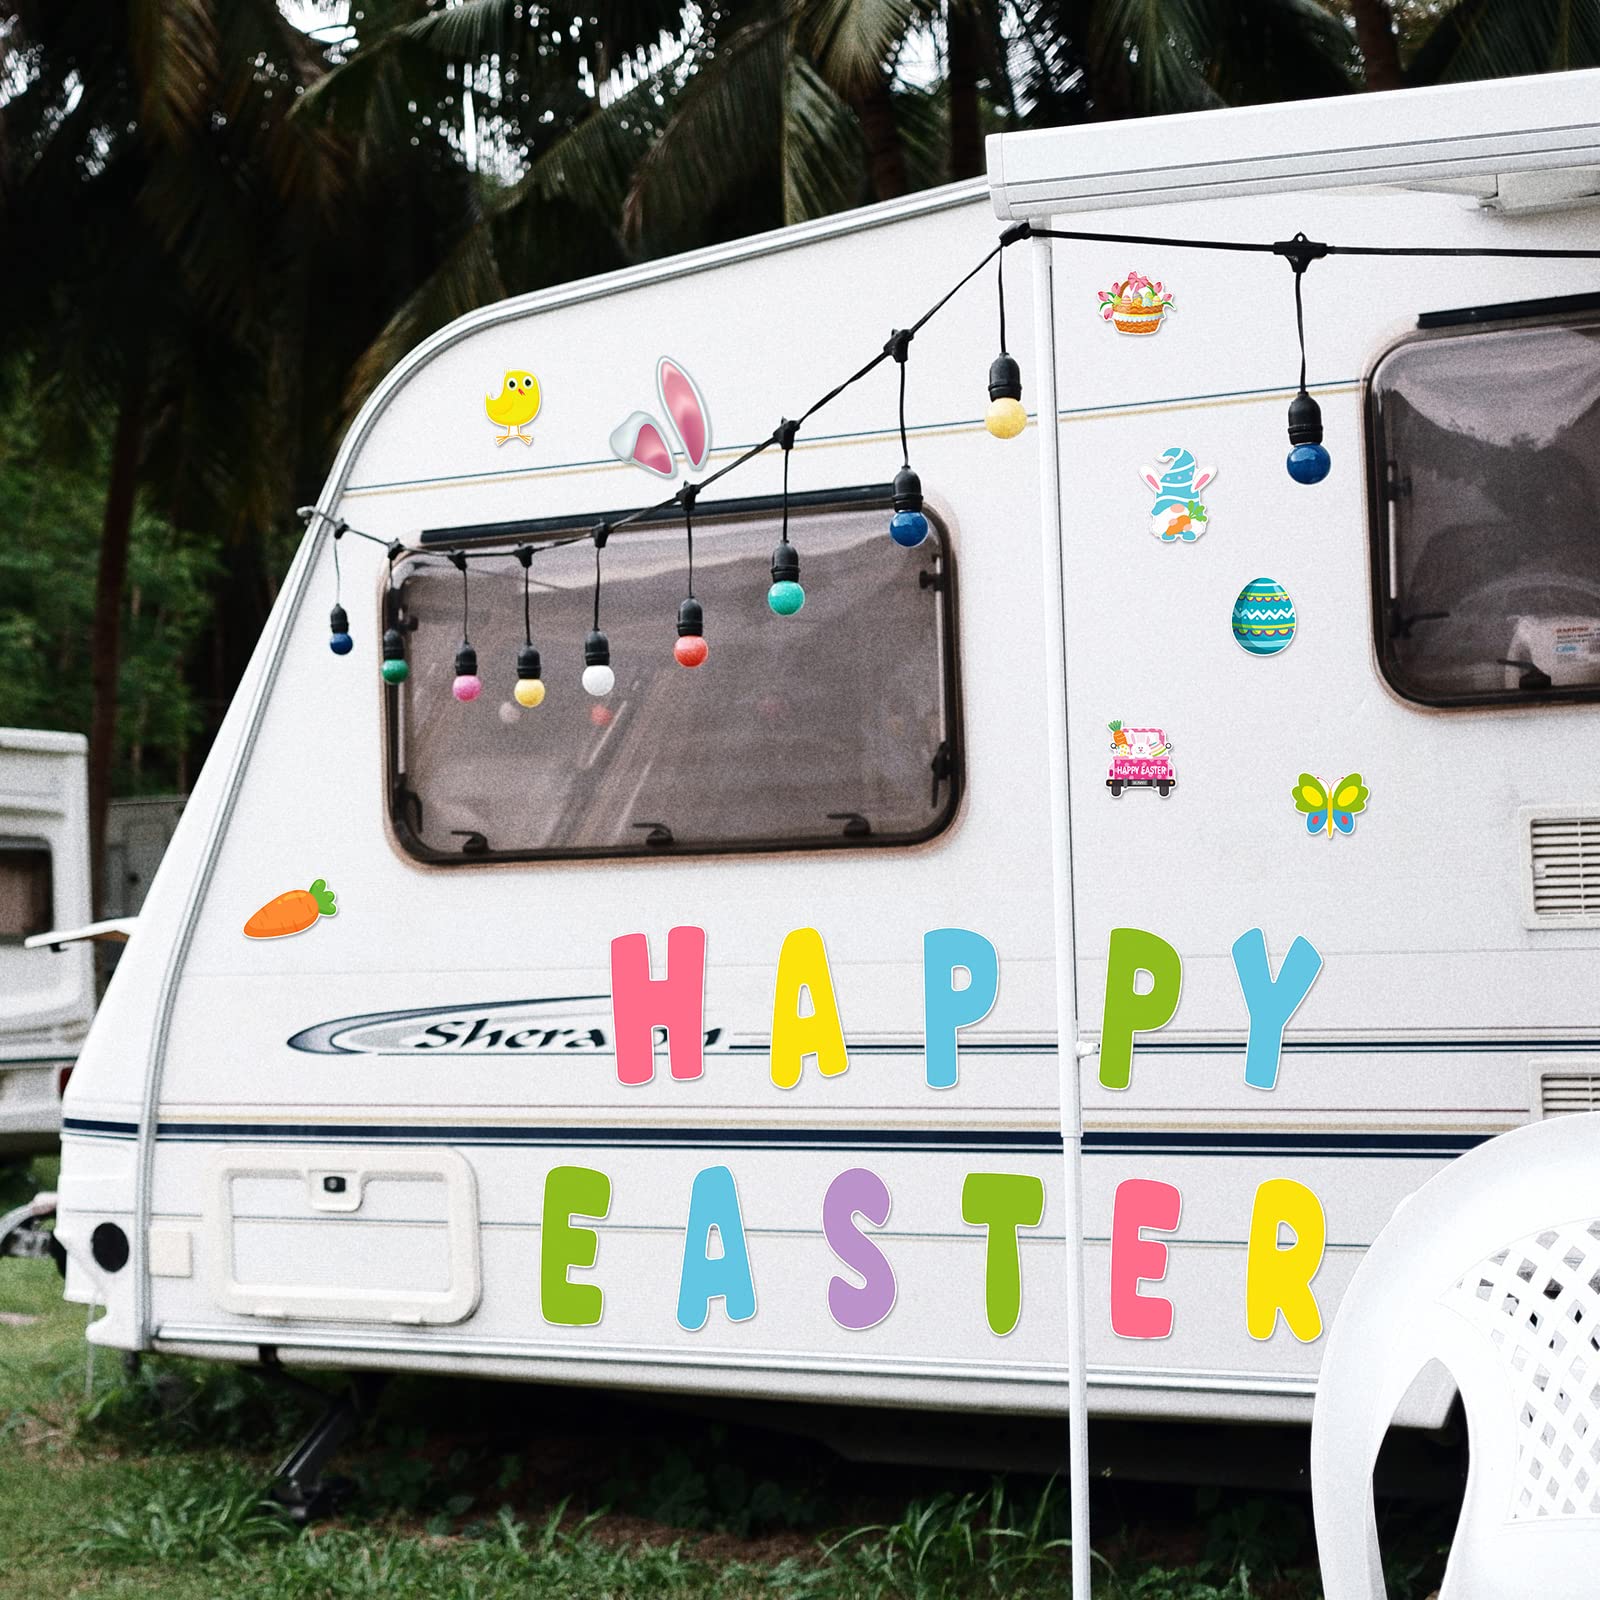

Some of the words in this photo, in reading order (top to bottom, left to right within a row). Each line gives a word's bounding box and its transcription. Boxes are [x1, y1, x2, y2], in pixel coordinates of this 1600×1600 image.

[1117, 766, 1139, 775] HAPPY
[1141, 766, 1167, 775] EASTER
[413, 1018, 722, 1048] Shera
[611, 926, 1322, 1089] HAPPY
[541, 1166, 1325, 1342] EASTER
